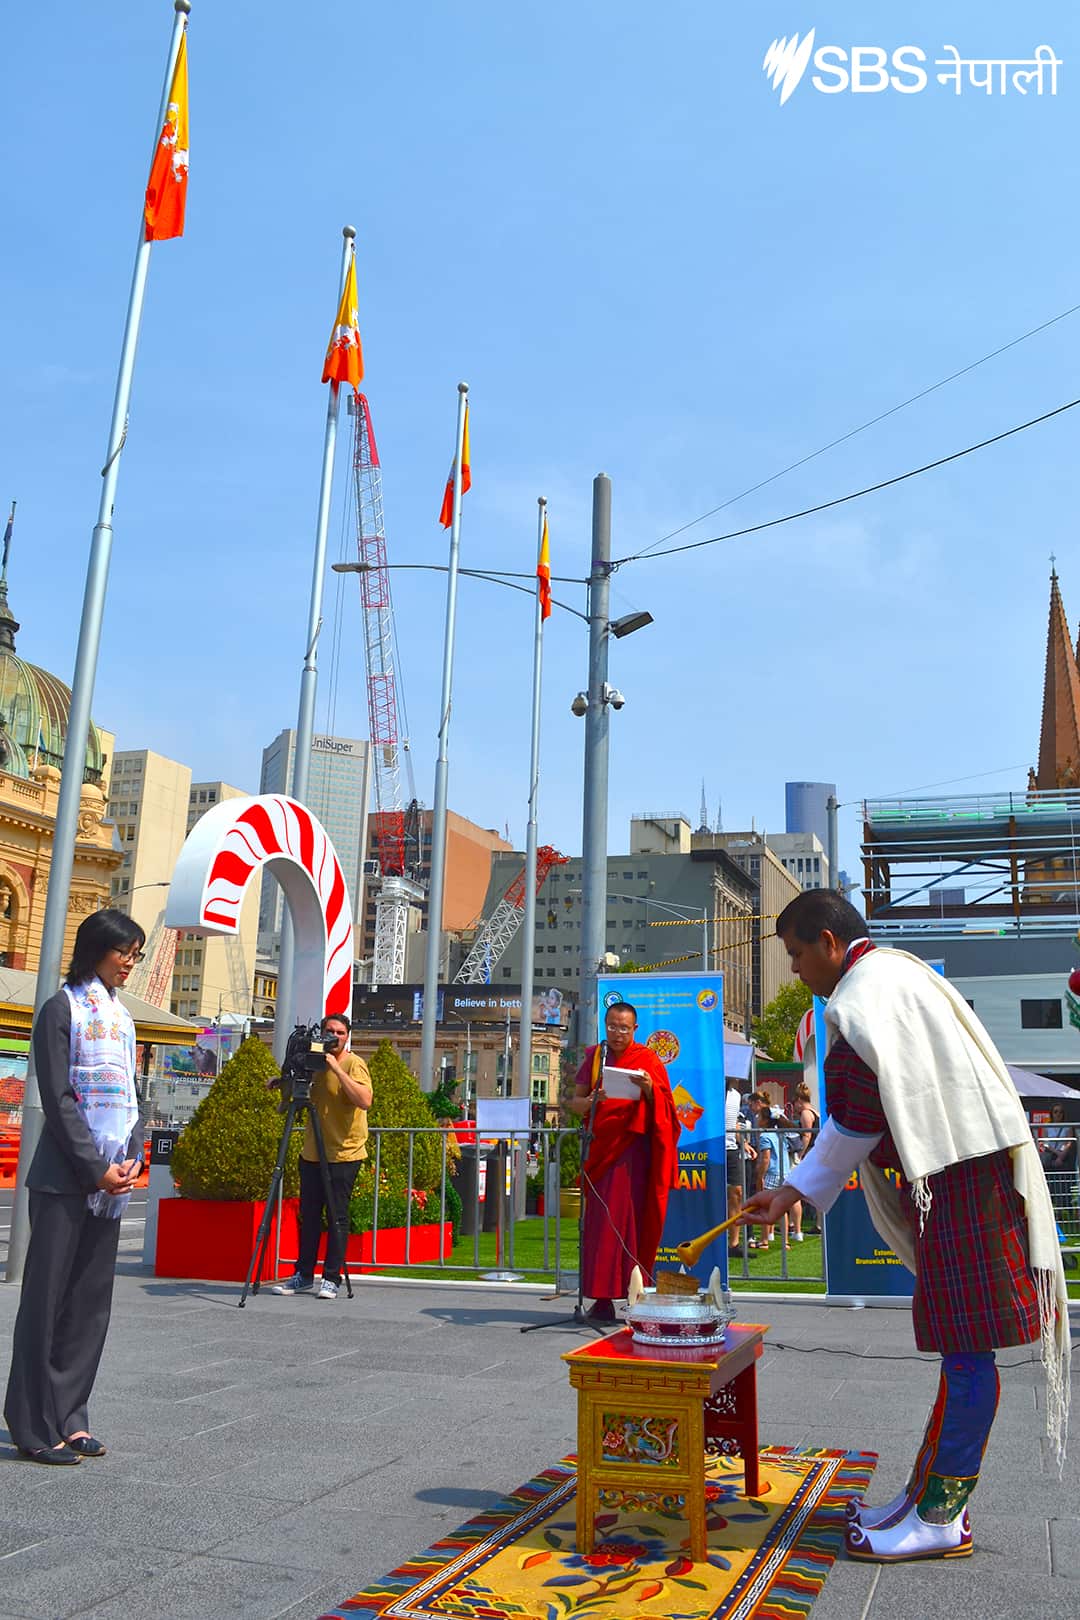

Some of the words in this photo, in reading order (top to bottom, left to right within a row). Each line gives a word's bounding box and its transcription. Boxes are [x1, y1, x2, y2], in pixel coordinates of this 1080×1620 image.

[454, 998, 486, 1008] Believe
[488, 998, 497, 1008] in
[679, 1152, 696, 1161] DAY
[697, 1152, 708, 1161] OF
